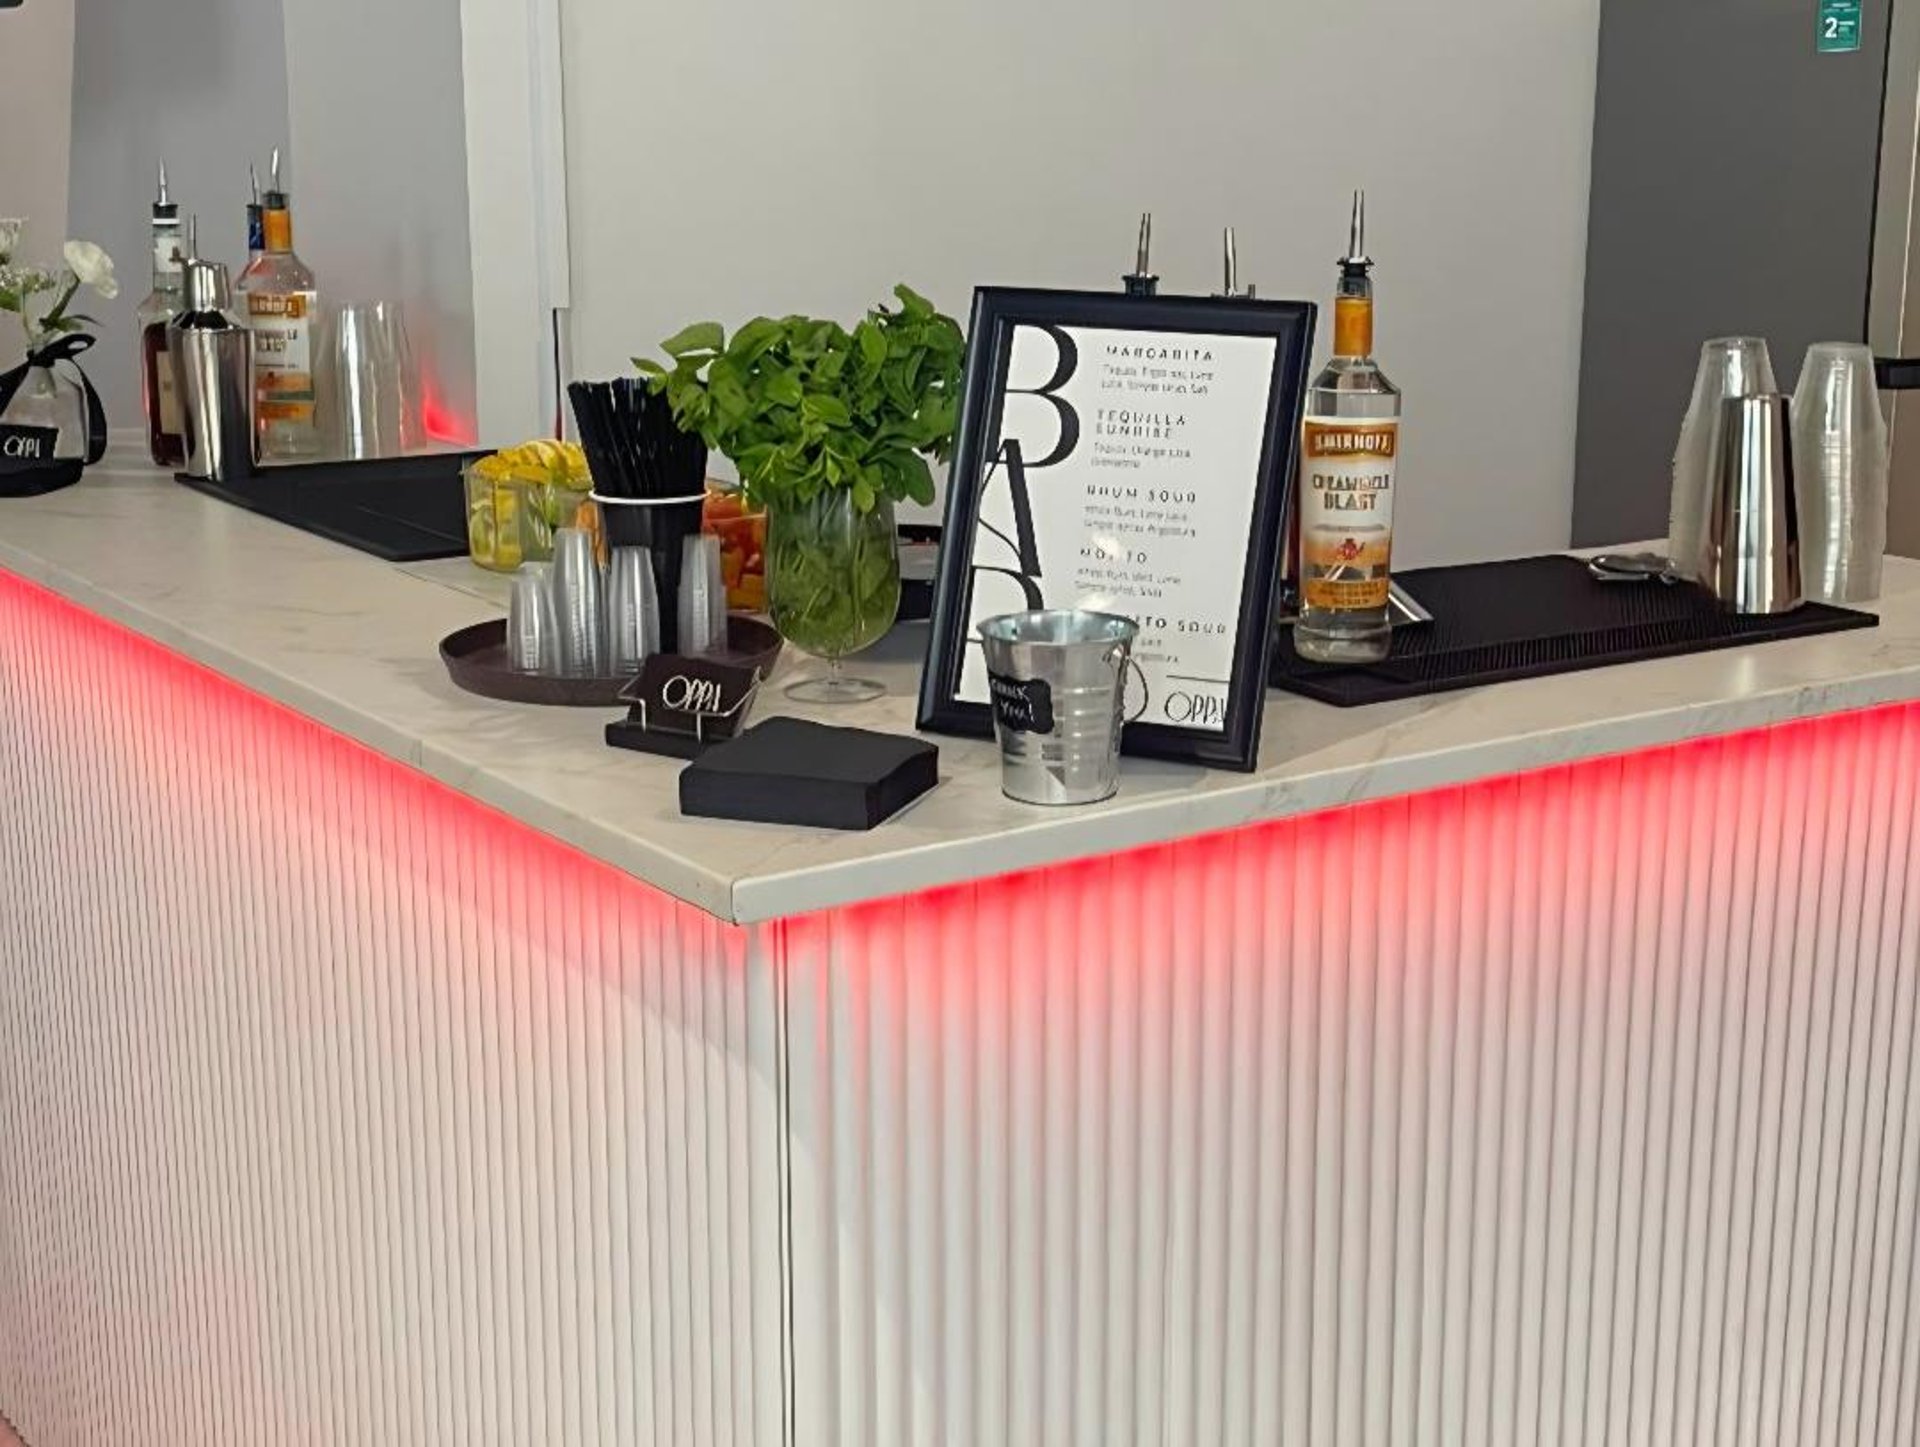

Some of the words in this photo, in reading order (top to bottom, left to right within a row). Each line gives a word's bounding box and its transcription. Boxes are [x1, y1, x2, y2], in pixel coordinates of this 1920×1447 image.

[1825, 16, 1838, 38] 2
[1106, 344, 1213, 361] MARGARITA
[1323, 492, 1377, 511] BLAST
